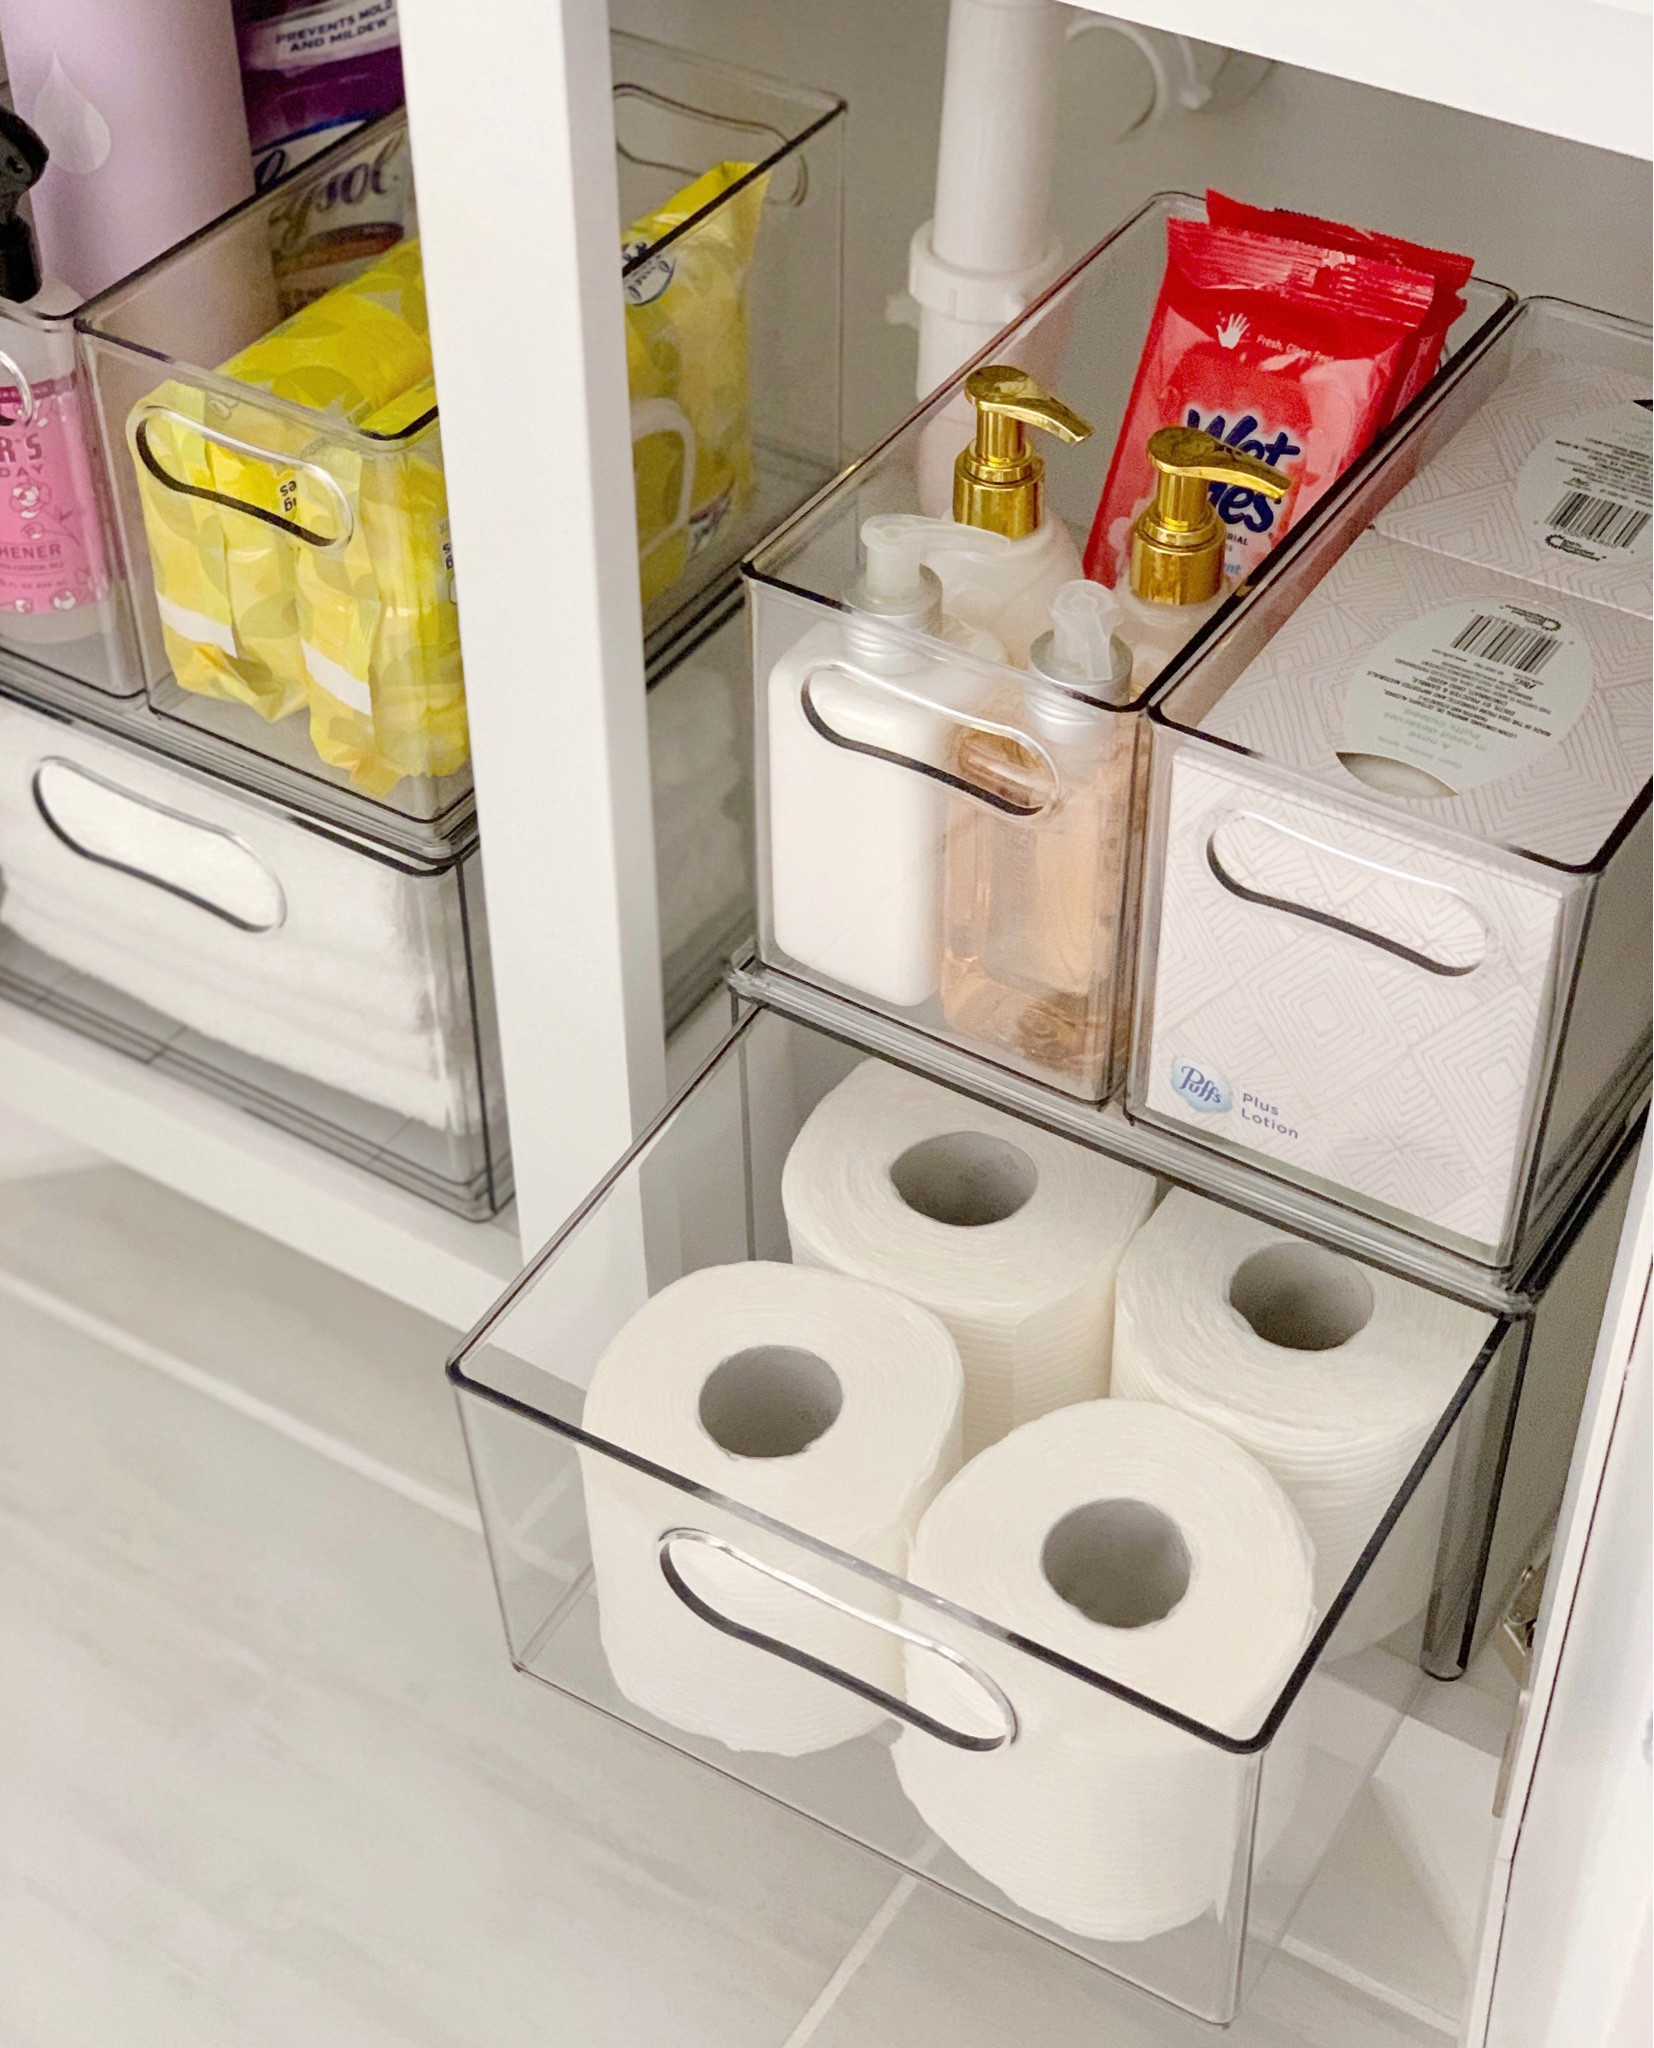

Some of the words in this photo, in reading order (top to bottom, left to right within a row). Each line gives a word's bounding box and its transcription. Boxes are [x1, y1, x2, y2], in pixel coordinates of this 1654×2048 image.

[276, 15, 355, 44] PREVENTS
[359, 0, 393, 19] MOLD
[289, 37, 325, 52] AND
[329, 18, 389, 44] MILDEW
[1179, 1065, 1222, 1103] Puffs
[1242, 1093, 1279, 1116] Plus
[1241, 1108, 1299, 1139] Lotion
